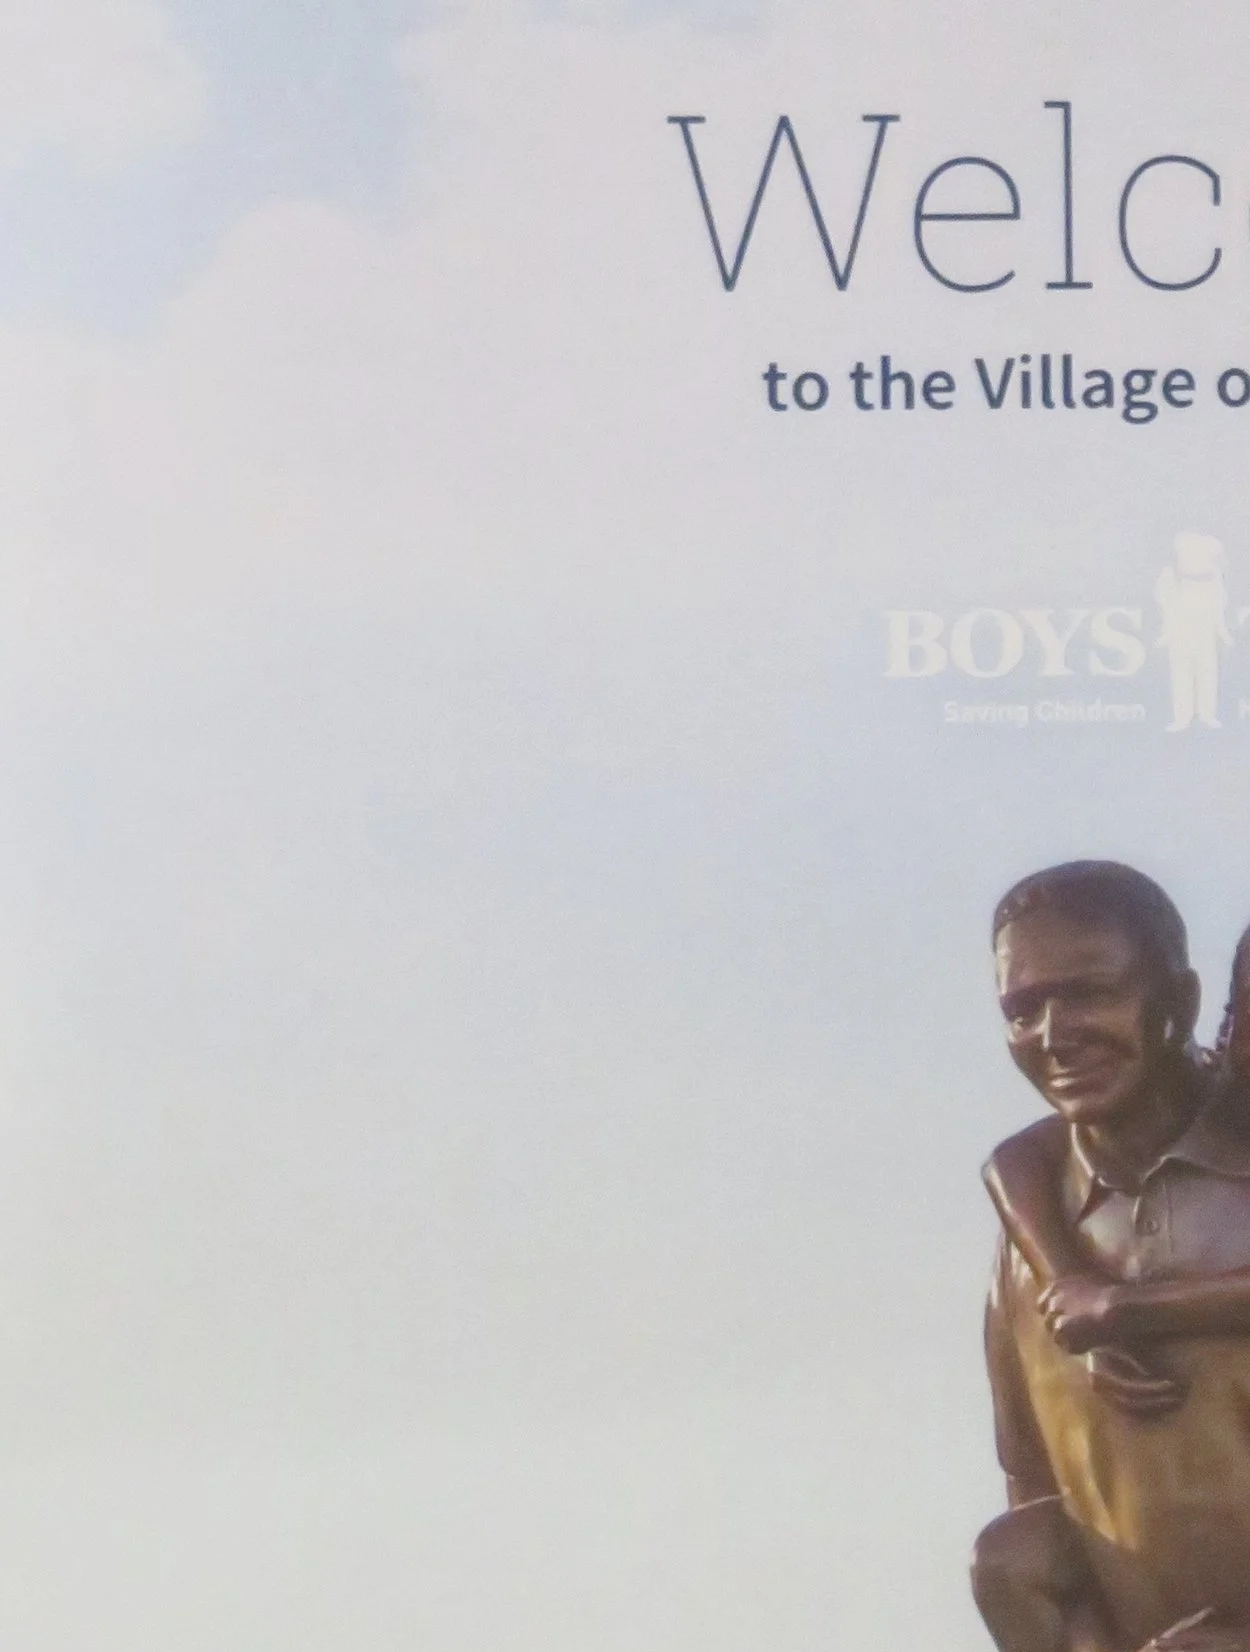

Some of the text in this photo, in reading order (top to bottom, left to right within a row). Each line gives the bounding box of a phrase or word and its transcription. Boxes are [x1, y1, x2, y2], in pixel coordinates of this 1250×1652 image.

[761, 361, 829, 413] to
[848, 354, 956, 412] the
[973, 353, 1196, 425] Village
[883, 606, 1147, 679] BOYS
[943, 698, 1146, 727] Saving Children
